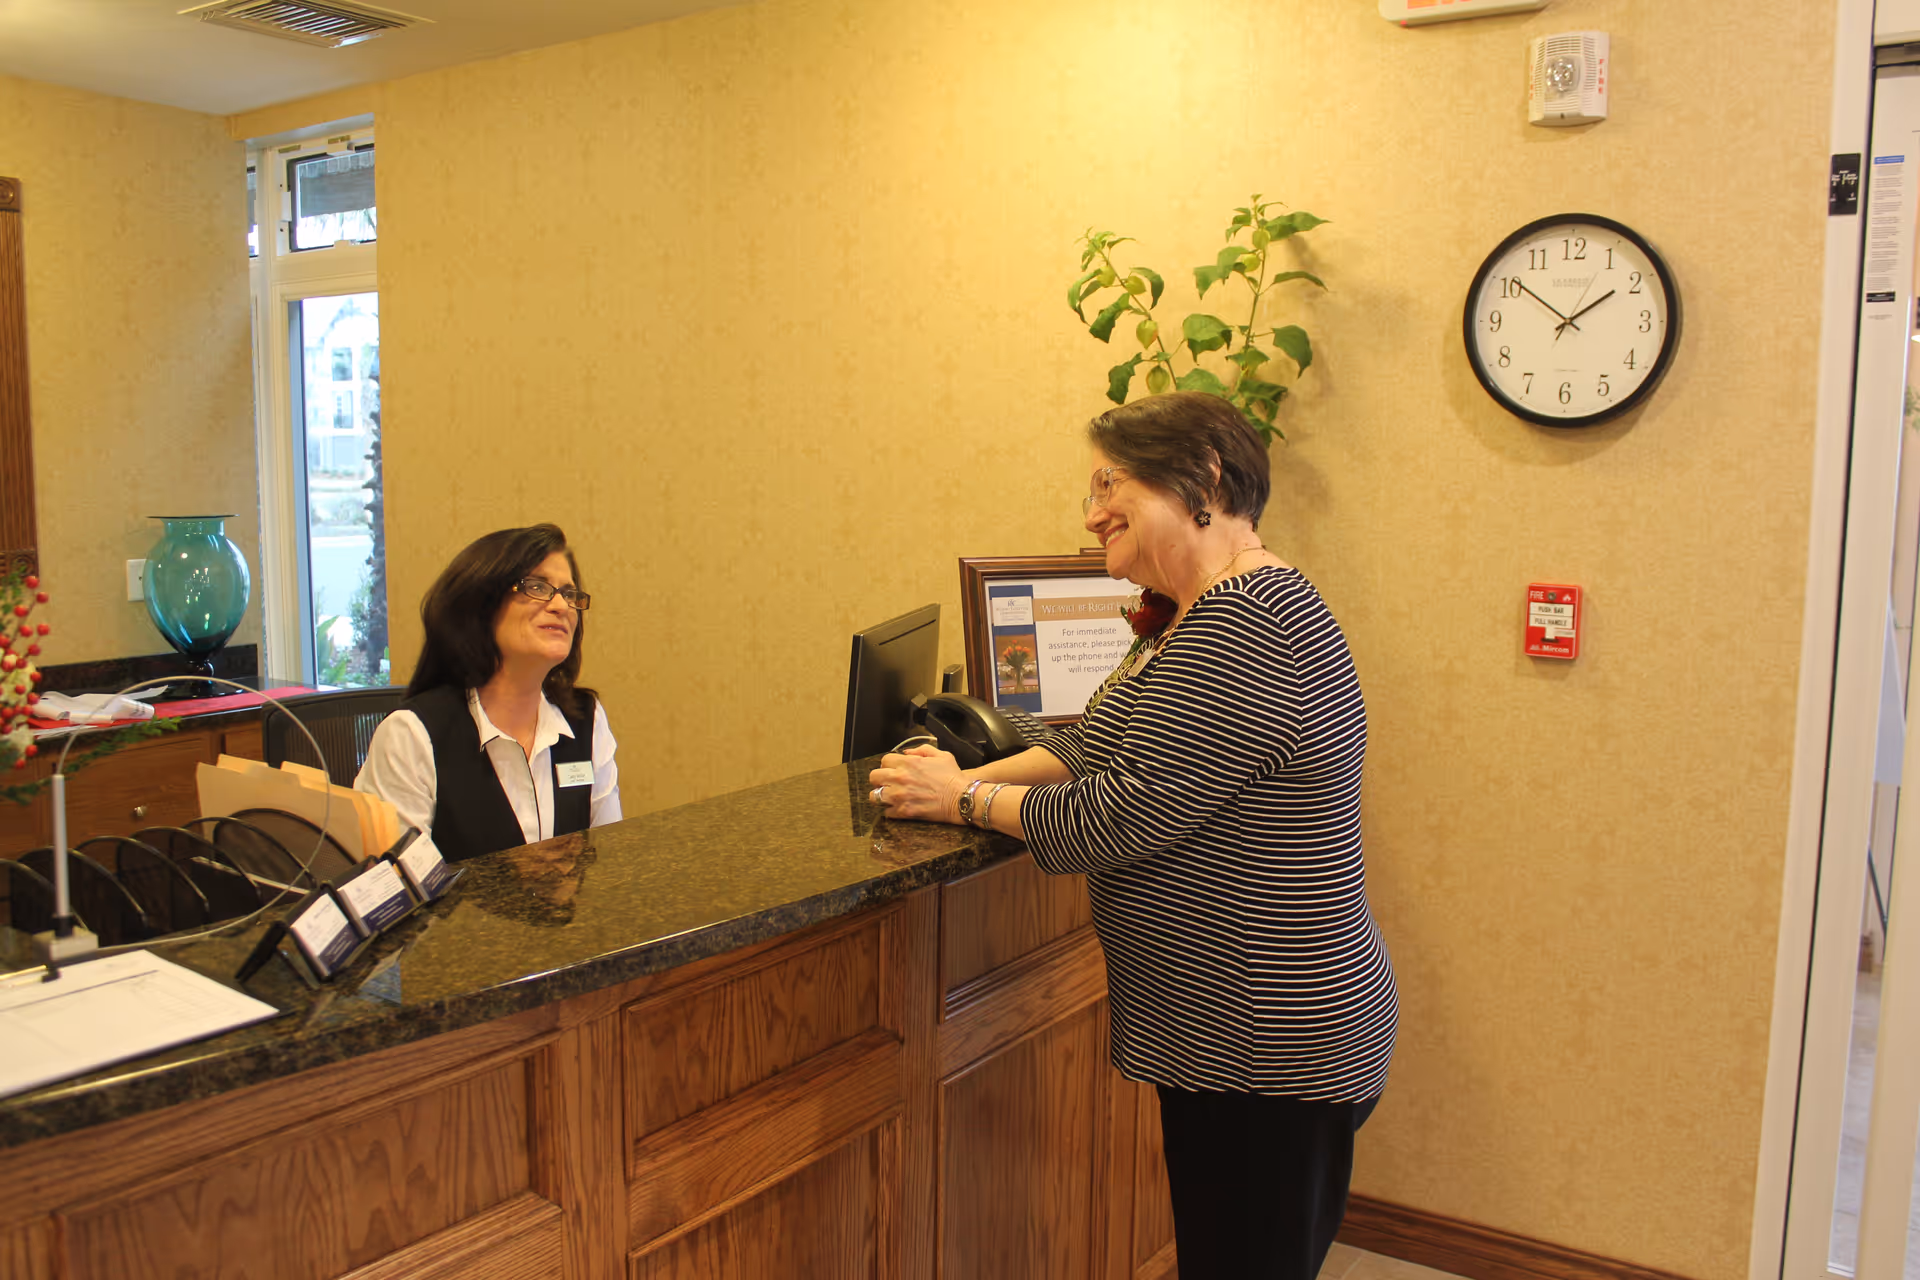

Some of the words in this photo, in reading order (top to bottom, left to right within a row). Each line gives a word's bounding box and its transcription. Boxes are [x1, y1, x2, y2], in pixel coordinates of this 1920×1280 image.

[1528, 248, 1548, 270] 11
[1562, 237, 1587, 260] 12
[1604, 248, 1616, 270] 1
[1499, 276, 1523, 298] 10
[1629, 271, 1642, 294] 2
[1489, 310, 1502, 333] 9
[1639, 310, 1652, 333] 3
[1498, 346, 1511, 368] 8
[1623, 348, 1637, 370] 4
[1522, 372, 1535, 395] 7
[1558, 382, 1572, 404] 6
[1597, 374, 1610, 396] 5
[1530, 590, 1544, 600] FIRE
[1062, 628, 1074, 637] For
[1076, 627, 1117, 636] immediate
[1048, 641, 1090, 650] assistance,
[1091, 640, 1116, 649] please
[1117, 639, 1132, 648] pick
[1051, 655, 1062, 664] up
[1063, 653, 1077, 661] the
[1080, 652, 1102, 663] phone
[1103, 651, 1118, 660] and
[1068, 665, 1082, 674] will
[1083, 664, 1114, 675] respond
